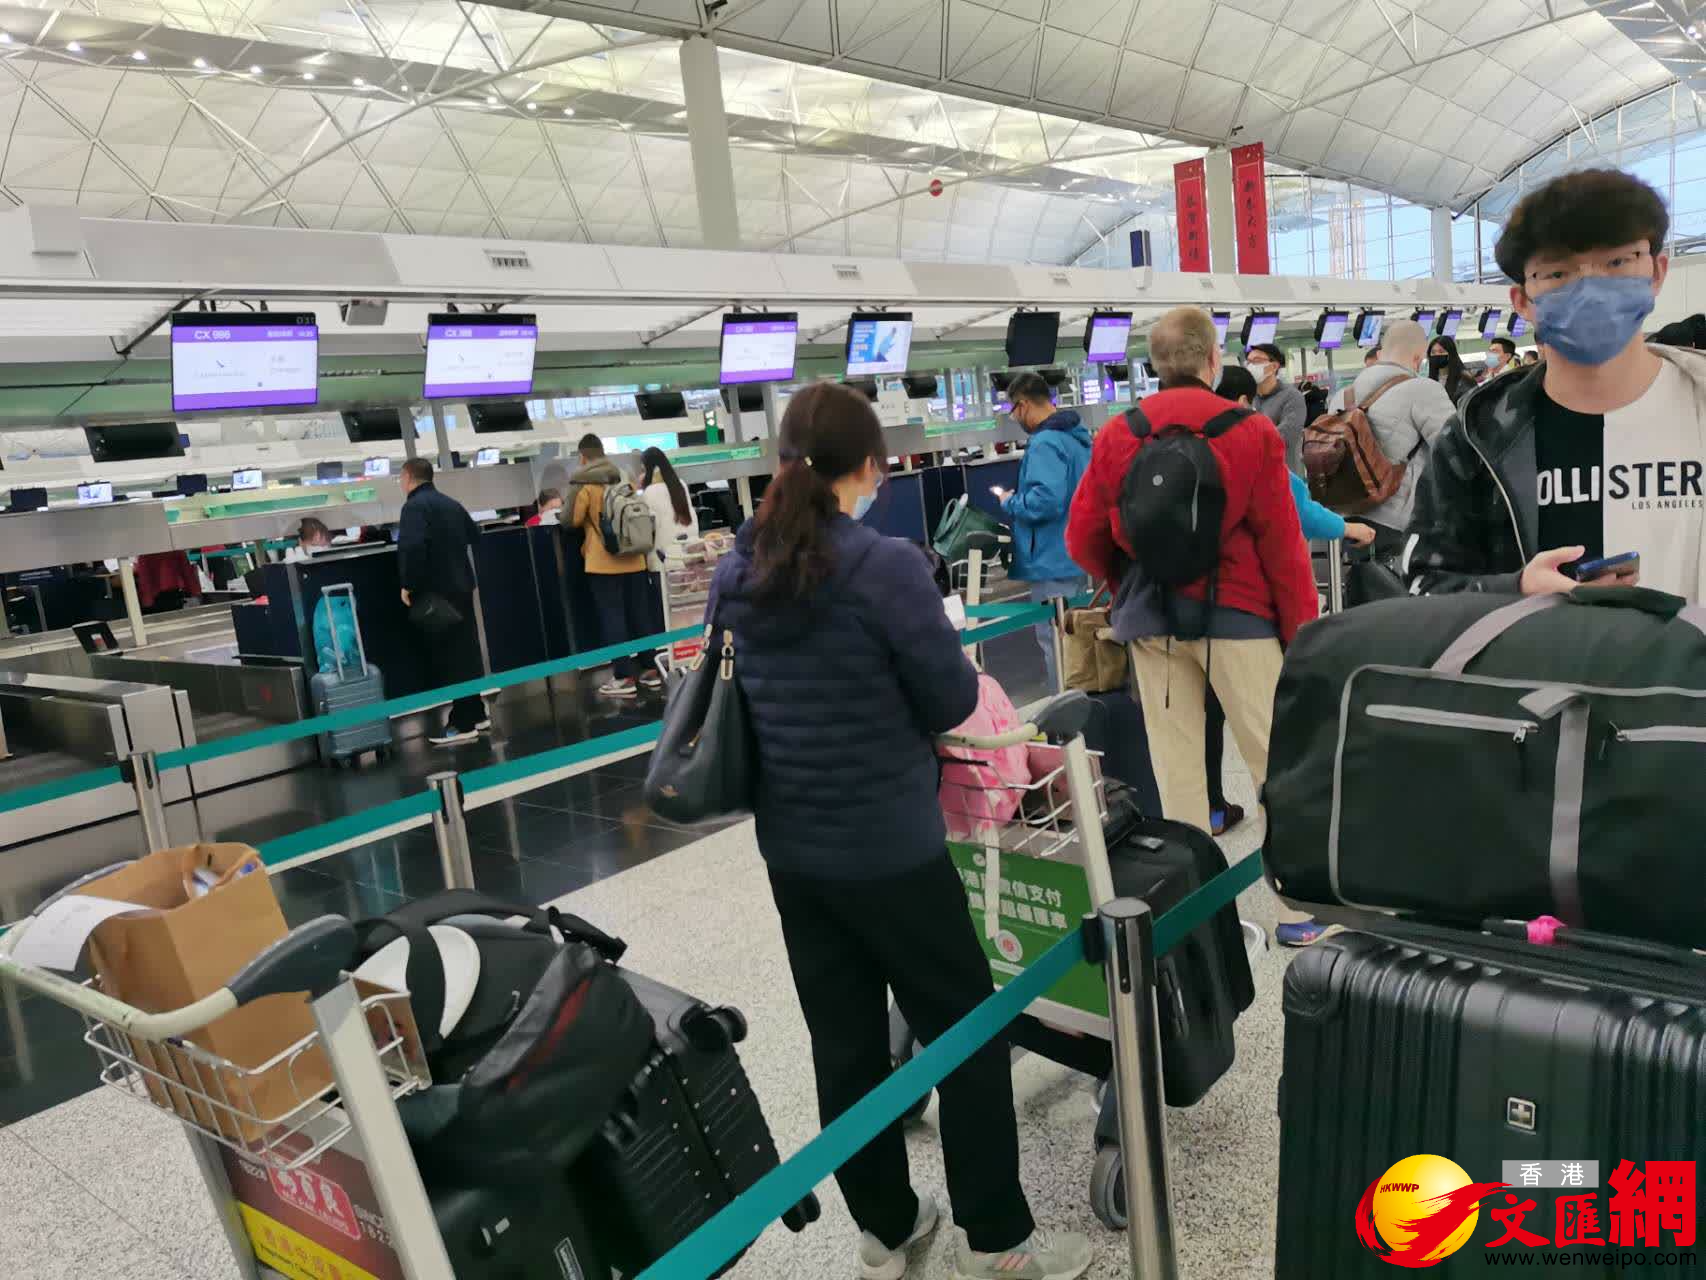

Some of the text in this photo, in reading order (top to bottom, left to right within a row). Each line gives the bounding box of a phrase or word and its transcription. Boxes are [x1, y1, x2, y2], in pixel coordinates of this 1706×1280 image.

[194, 330, 211, 340] CX
[1536, 461, 1703, 506] OLLISTER
[1632, 499, 1704, 510] LOS ANGELES
